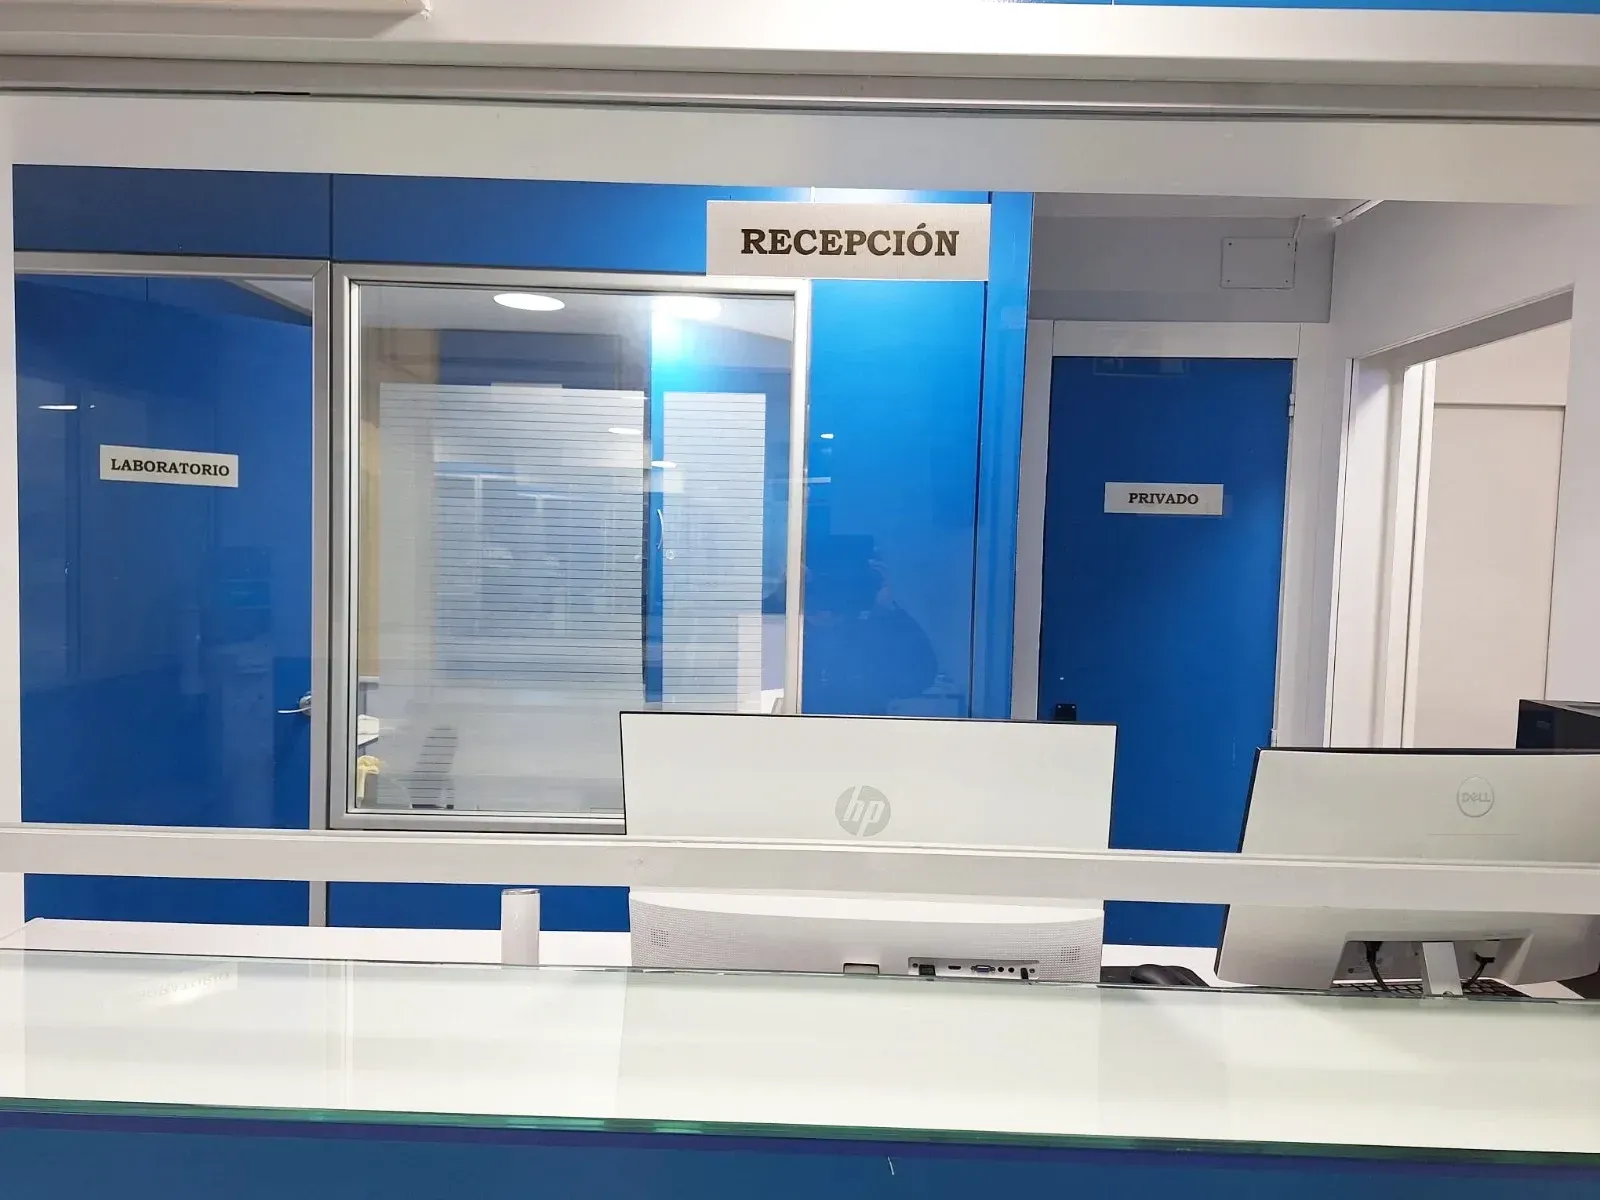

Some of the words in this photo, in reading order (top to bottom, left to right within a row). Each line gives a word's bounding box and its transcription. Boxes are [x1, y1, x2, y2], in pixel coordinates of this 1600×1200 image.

[740, 222, 960, 257] RECEPCIÓN
[110, 458, 230, 477] LABORATORIO
[1128, 492, 1199, 505] PRIVADO
